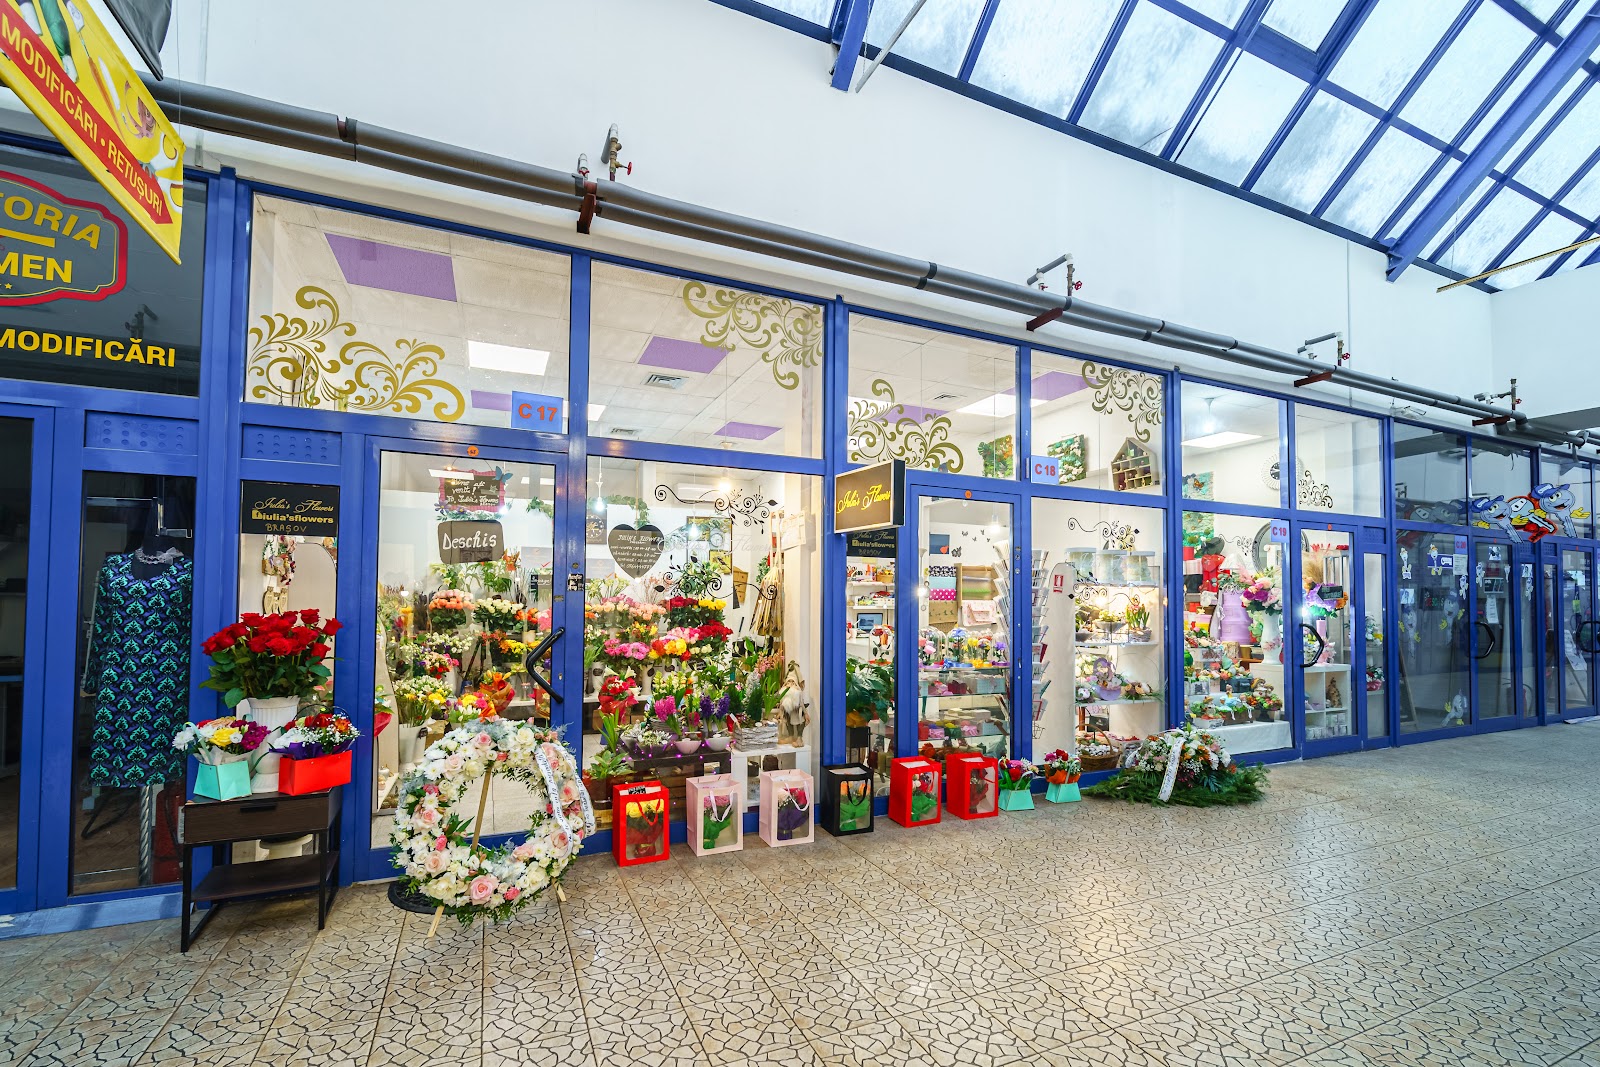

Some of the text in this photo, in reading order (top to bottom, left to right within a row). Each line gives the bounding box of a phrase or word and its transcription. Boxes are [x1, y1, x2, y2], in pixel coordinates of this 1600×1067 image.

[2, 13, 98, 143] MODIFICĂRI
[0, 192, 101, 250] ORIA
[518, 403, 558, 422] C 17
[1035, 464, 1056, 476] C 18
[442, 530, 497, 550] Deschis
[1272, 526, 1287, 537] C 19
